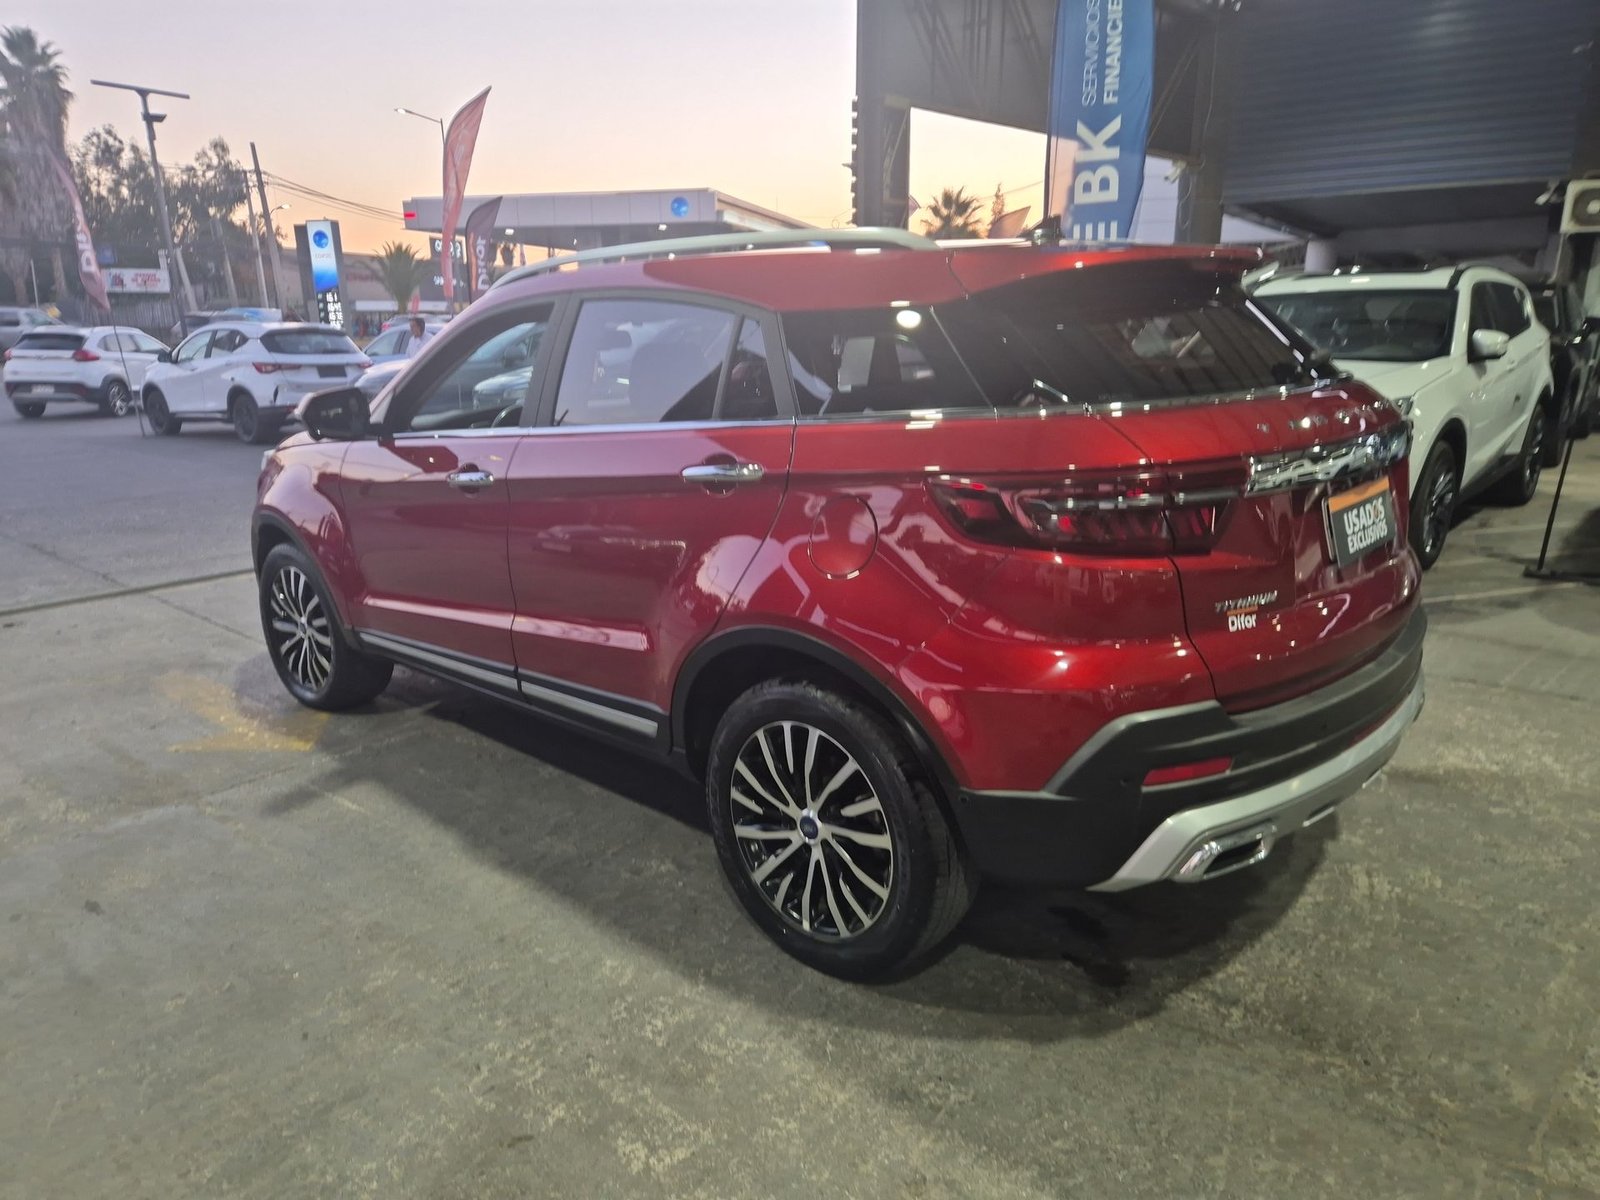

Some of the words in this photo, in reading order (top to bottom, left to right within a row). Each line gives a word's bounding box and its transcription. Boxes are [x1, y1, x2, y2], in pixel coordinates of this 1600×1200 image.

[1082, 0, 1101, 107] SERVICIOS
[1074, 114, 1121, 205] BK
[1343, 496, 1385, 535] USADOS
[1347, 518, 1388, 554] EXCLUSIVOS
[1228, 613, 1257, 633] Difor
